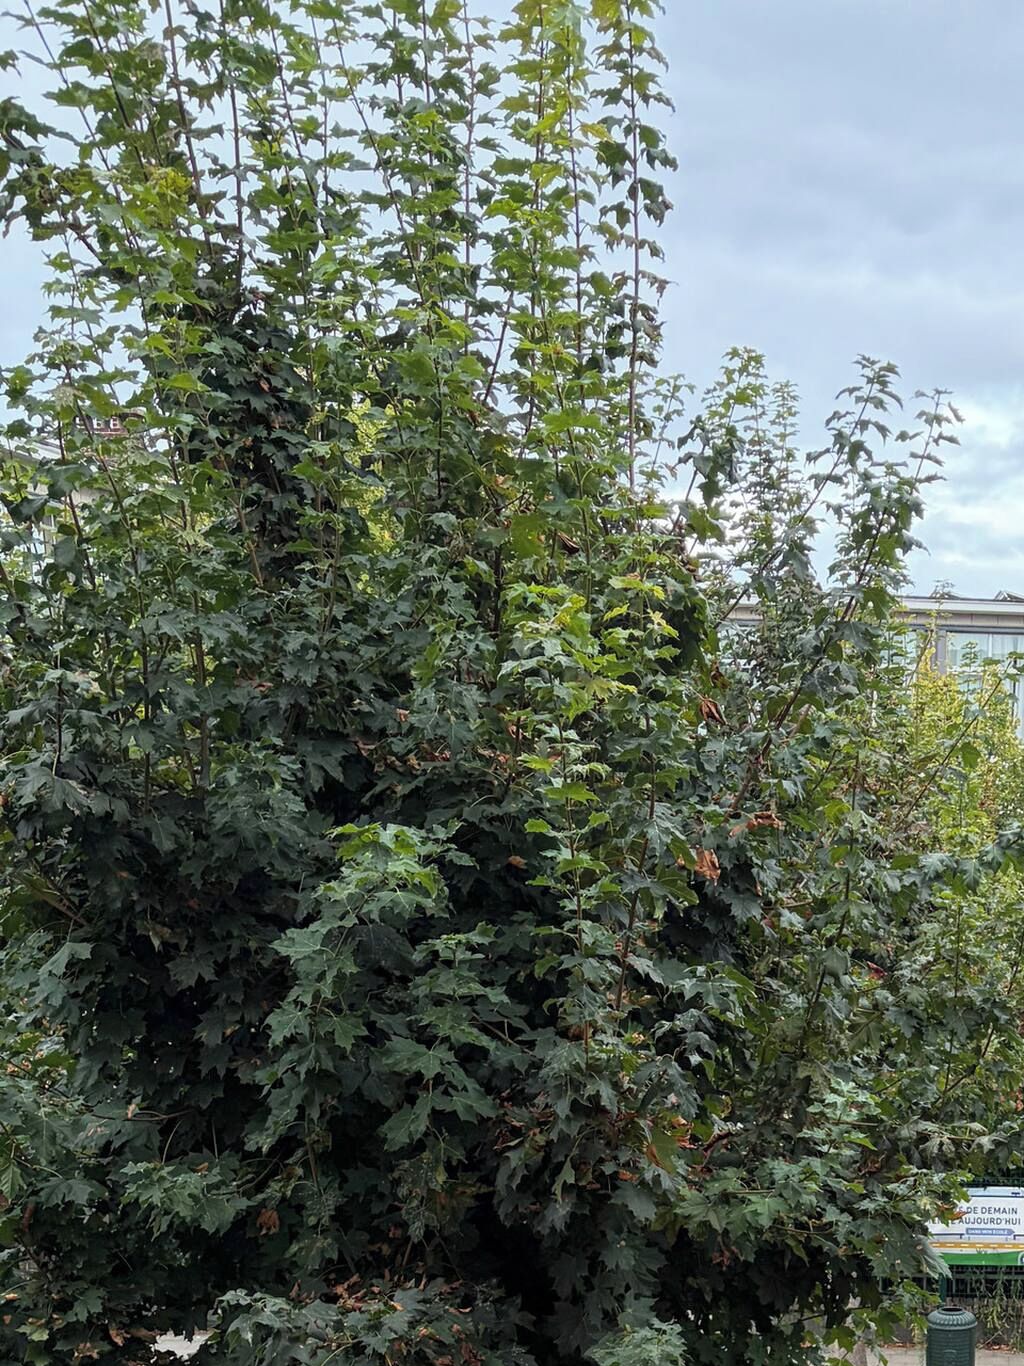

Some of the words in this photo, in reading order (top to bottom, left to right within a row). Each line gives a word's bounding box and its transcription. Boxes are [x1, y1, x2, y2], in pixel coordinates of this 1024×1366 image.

[966, 1206, 978, 1214] DE
[981, 1206, 1018, 1215] DEMAIN
[958, 1217, 1021, 1225] AUJOURD'HUI
